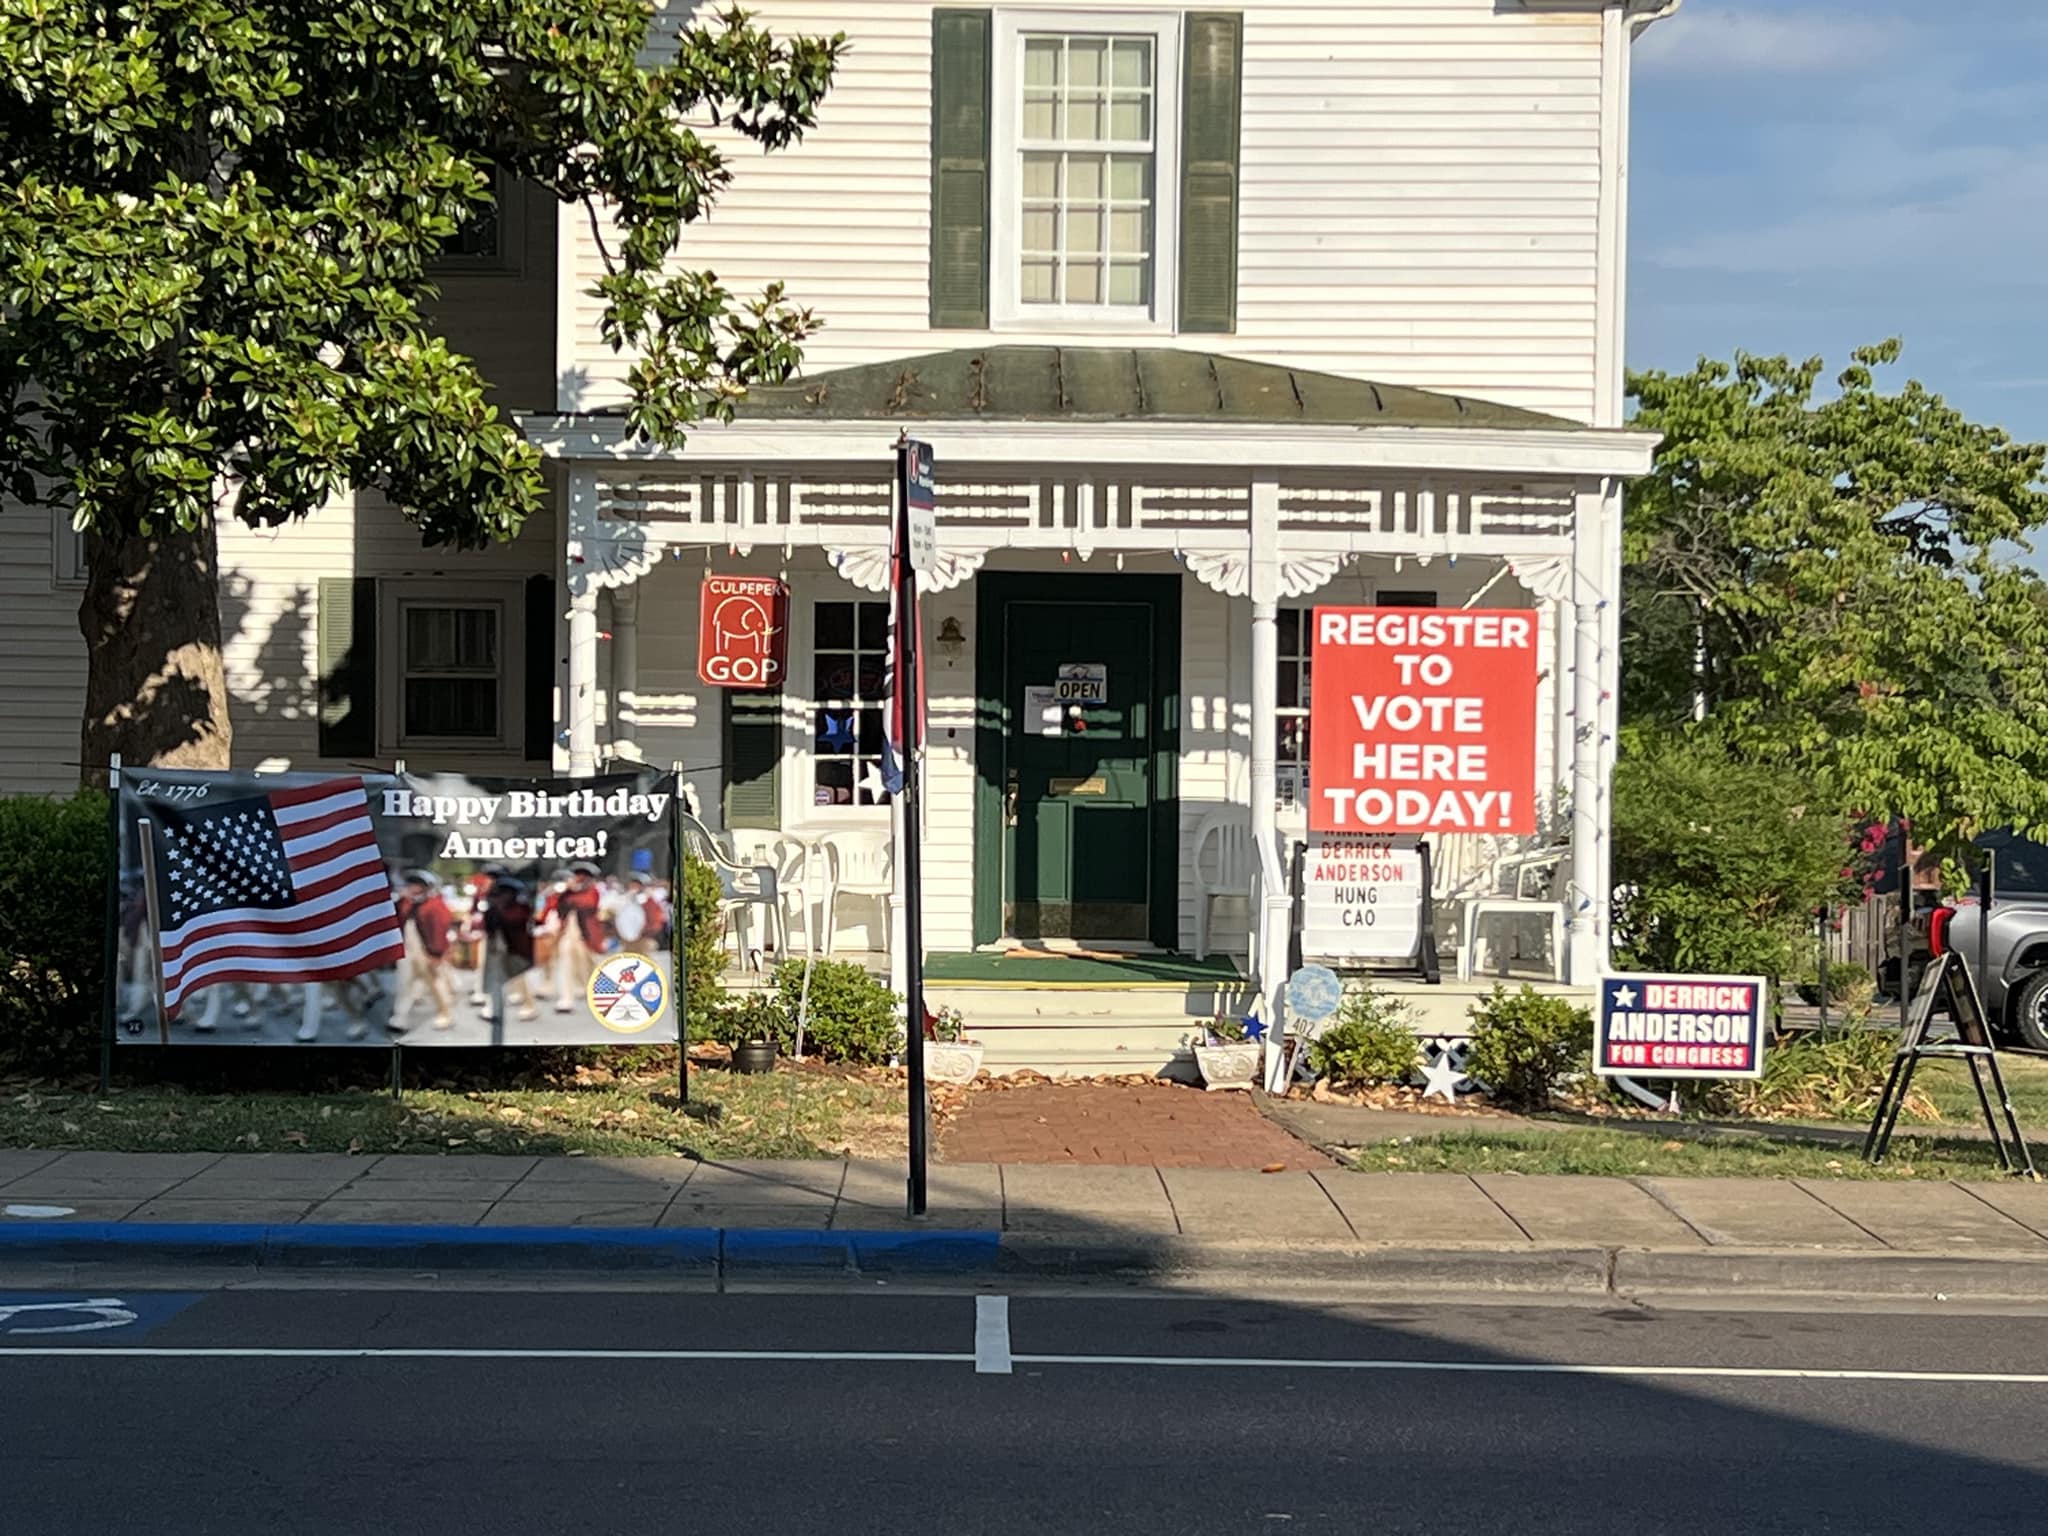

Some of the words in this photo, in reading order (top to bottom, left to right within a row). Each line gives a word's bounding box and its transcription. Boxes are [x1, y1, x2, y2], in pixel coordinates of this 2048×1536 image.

[710, 581, 781, 596] CULPEPER
[1319, 614, 1529, 648] REGISTER
[706, 656, 778, 682] GOP
[1393, 654, 1452, 686] TO
[1060, 682, 1101, 698] OPEN
[1351, 695, 1485, 733] VOTE
[1353, 744, 1488, 781] HERE
[165, 782, 212, 802] 1776
[382, 790, 503, 826] Happy
[508, 788, 669, 824] Birthday
[1324, 789, 1512, 828] TODAY!
[440, 831, 608, 859] America!
[1321, 841, 1392, 859] DERRICK
[1314, 864, 1403, 881] ANDERSON
[1334, 887, 1377, 904] HUNG
[1342, 909, 1376, 926] CAO
[1646, 984, 1749, 1011] DERRICK
[1292, 1017, 1316, 1037] 402
[1608, 1012, 1750, 1044] ANDERSON
[1611, 1044, 1645, 1064] FOR
[1651, 1046, 1744, 1066] CONGRESS
